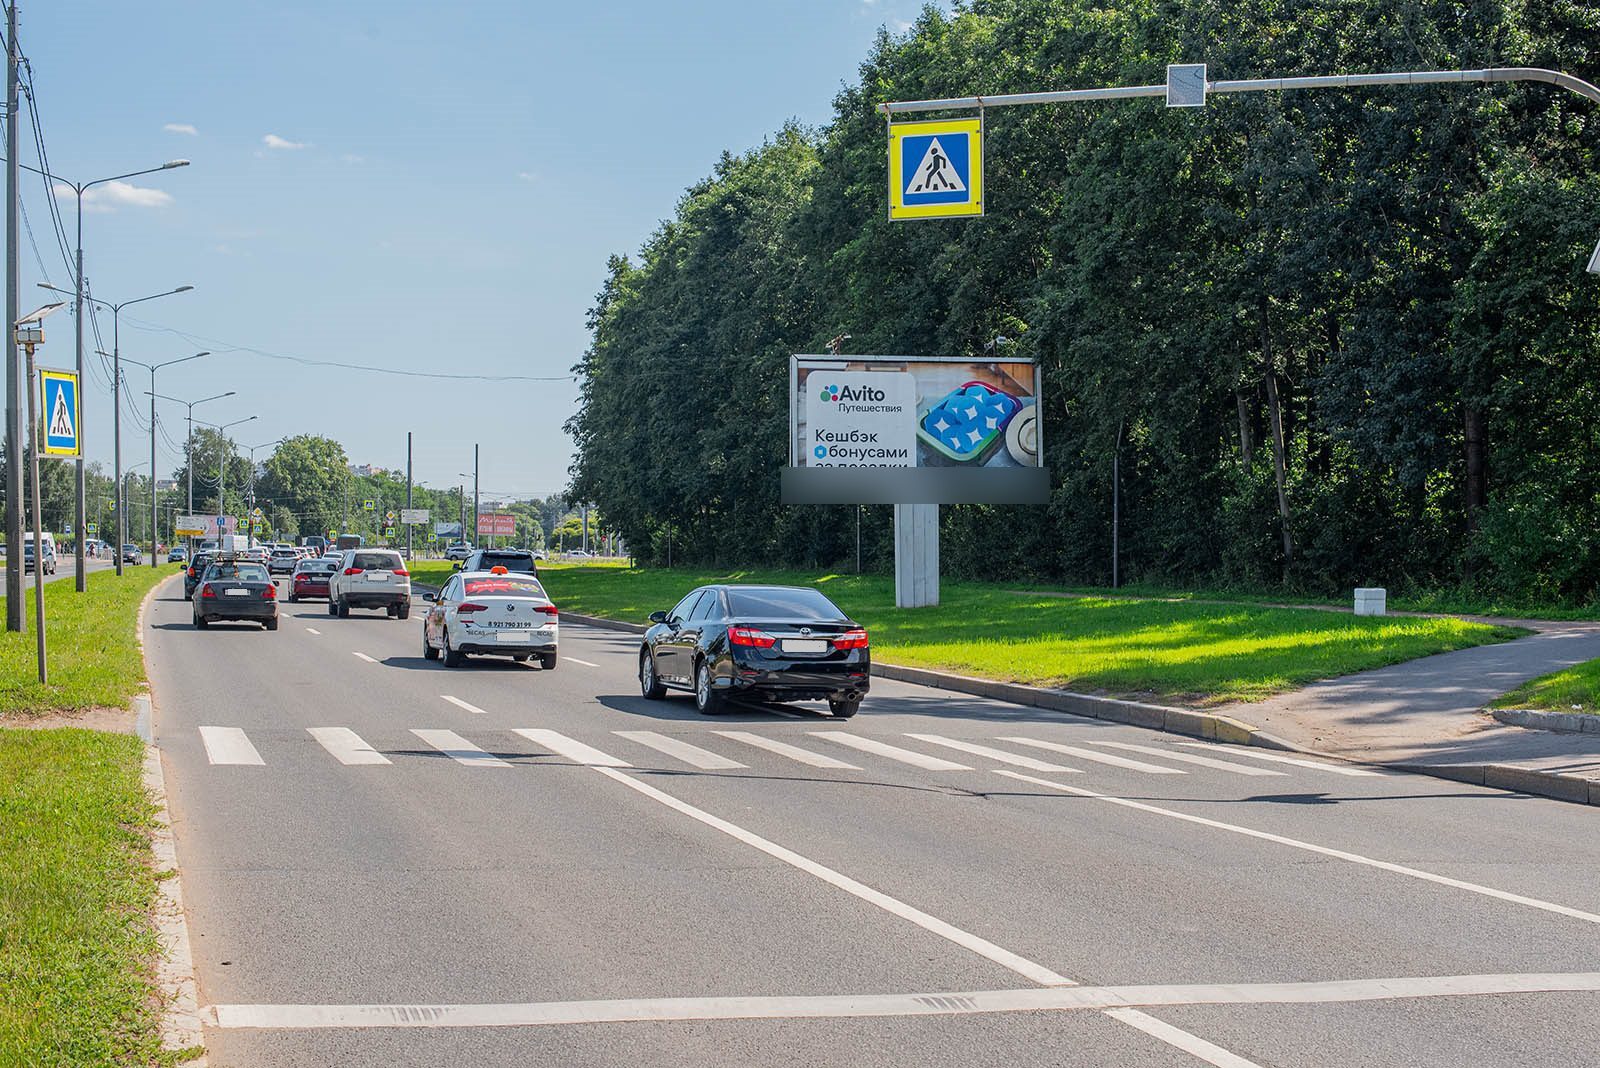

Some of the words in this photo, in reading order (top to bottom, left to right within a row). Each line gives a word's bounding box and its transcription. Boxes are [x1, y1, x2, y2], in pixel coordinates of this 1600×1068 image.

[839, 385, 885, 401] Avito
[838, 403, 902, 414] Путешествия
[815, 429, 878, 442] Кешбэк
[829, 444, 908, 461] бонусами
